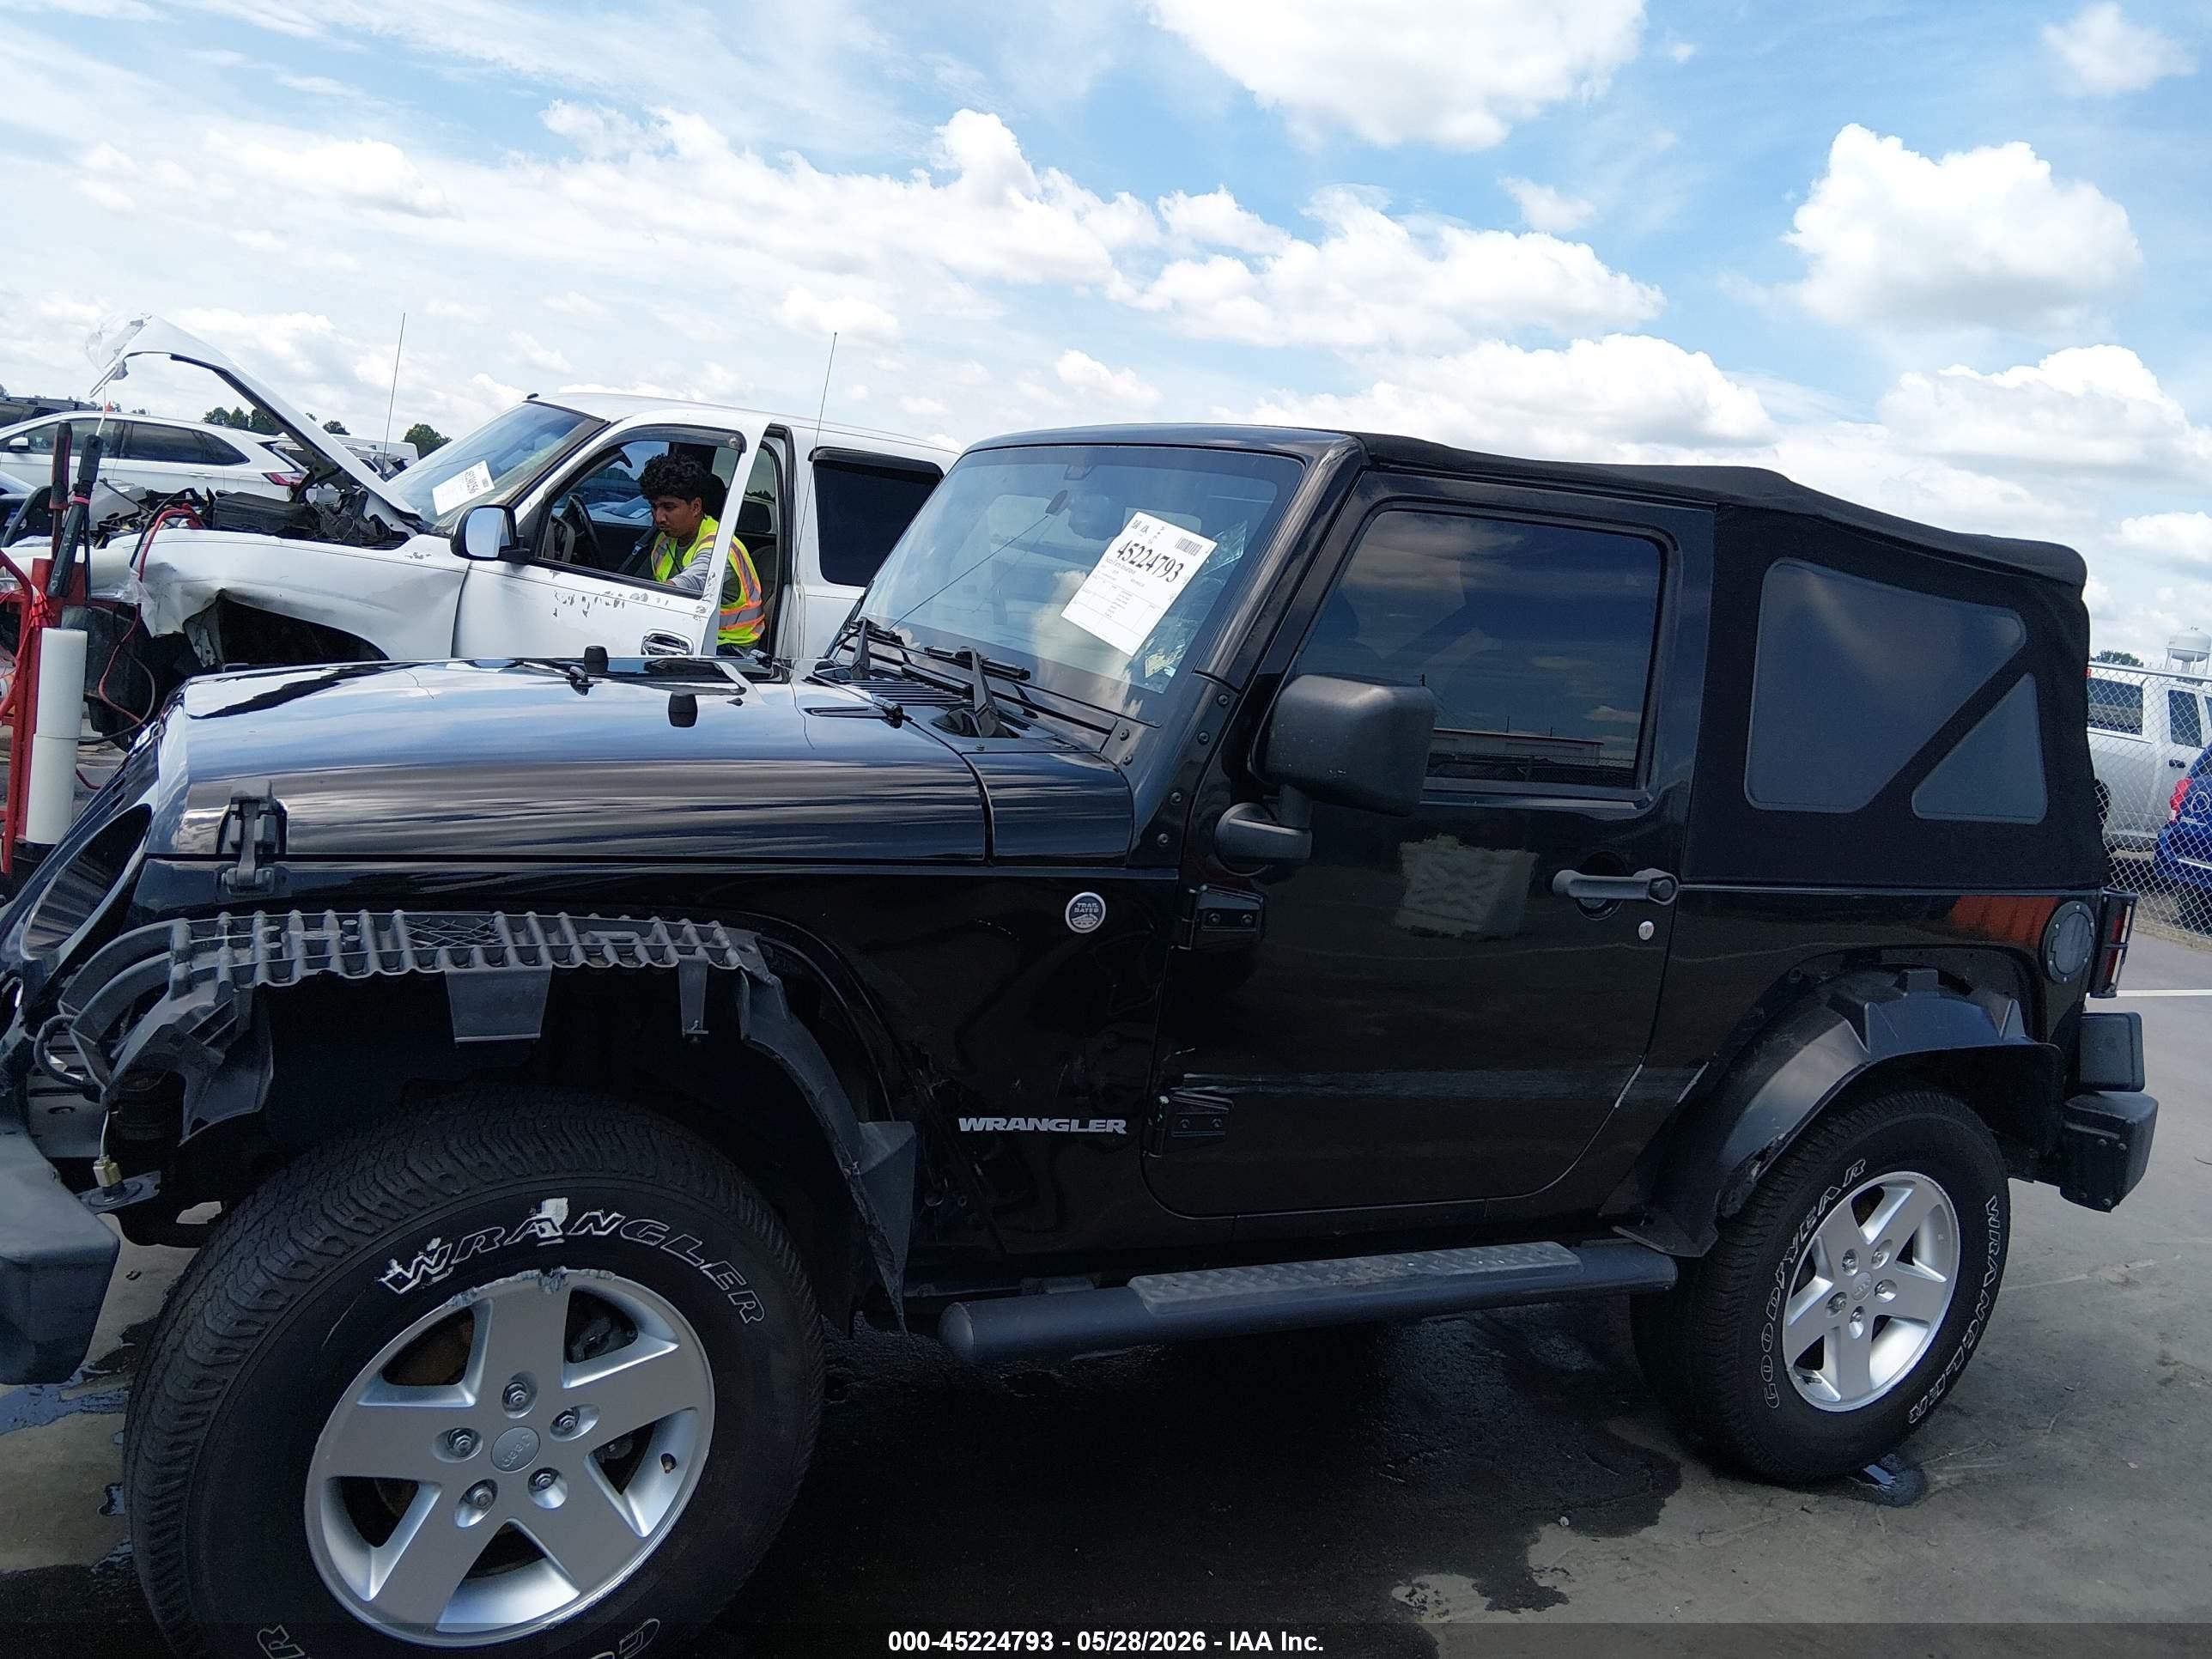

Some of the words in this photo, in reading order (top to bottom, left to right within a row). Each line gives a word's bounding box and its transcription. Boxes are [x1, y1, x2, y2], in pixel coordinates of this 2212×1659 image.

[1117, 540, 1184, 583] 45224793
[958, 1117, 1127, 1135] WRANGLER
[380, 1206, 766, 1325] WRANGLER
[1761, 1158, 1867, 1409] GOODYEAR
[1908, 1194, 2002, 1424] WRANGLER
